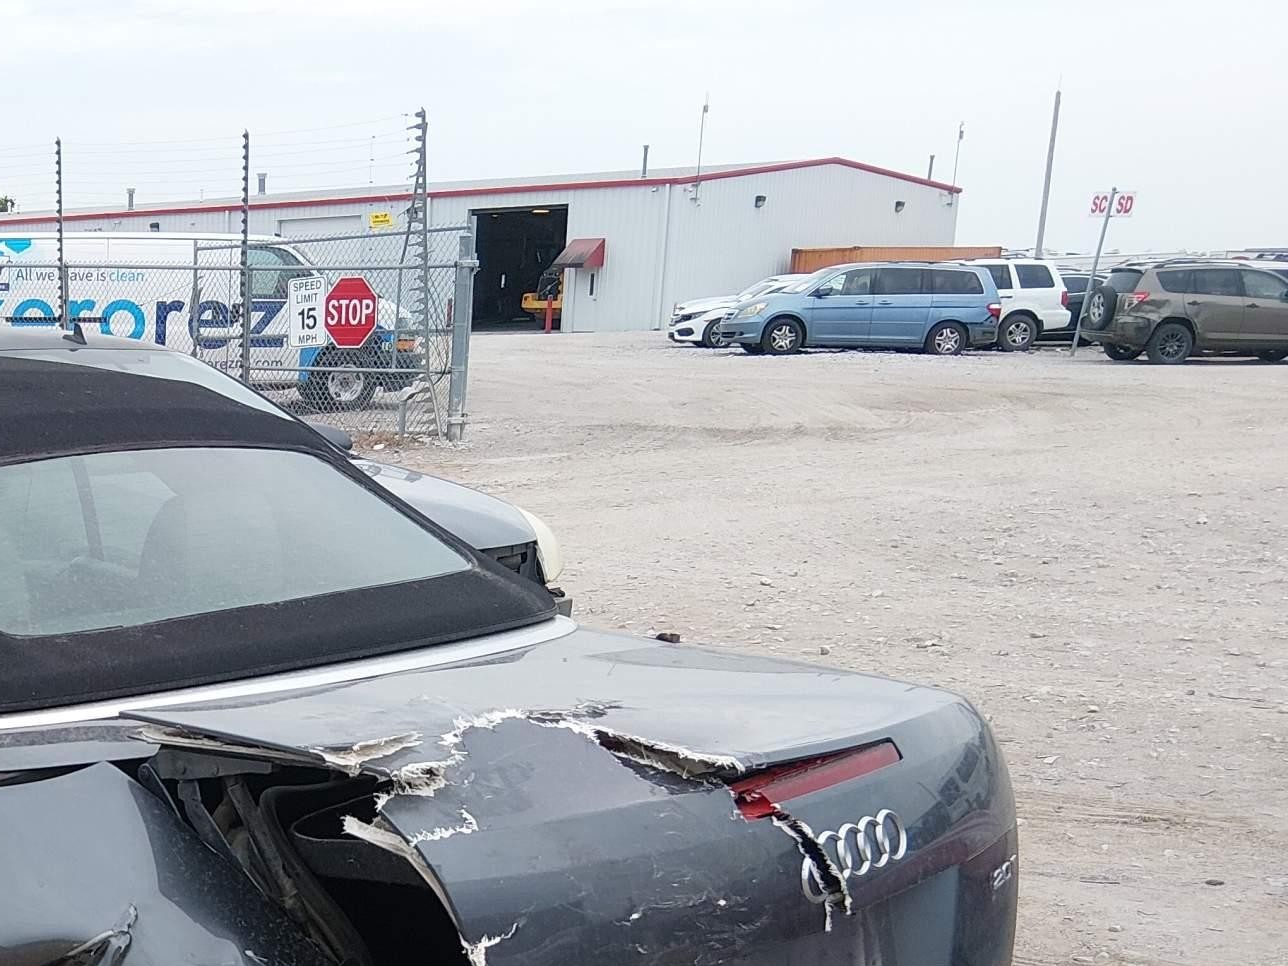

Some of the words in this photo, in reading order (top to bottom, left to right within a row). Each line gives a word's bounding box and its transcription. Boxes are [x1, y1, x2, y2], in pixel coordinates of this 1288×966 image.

[1091, 195, 1108, 214] SC
[1116, 195, 1133, 214] SD
[16, 267, 32, 282] All
[36, 271, 55, 282] we
[62, 269, 94, 282] ave
[97, 268, 107, 282] is
[293, 280, 321, 292] SPEED
[296, 293, 318, 304] LIMIT
[298, 307, 317, 330] 15
[327, 299, 373, 325] STOP
[298, 333, 317, 344] MPH
